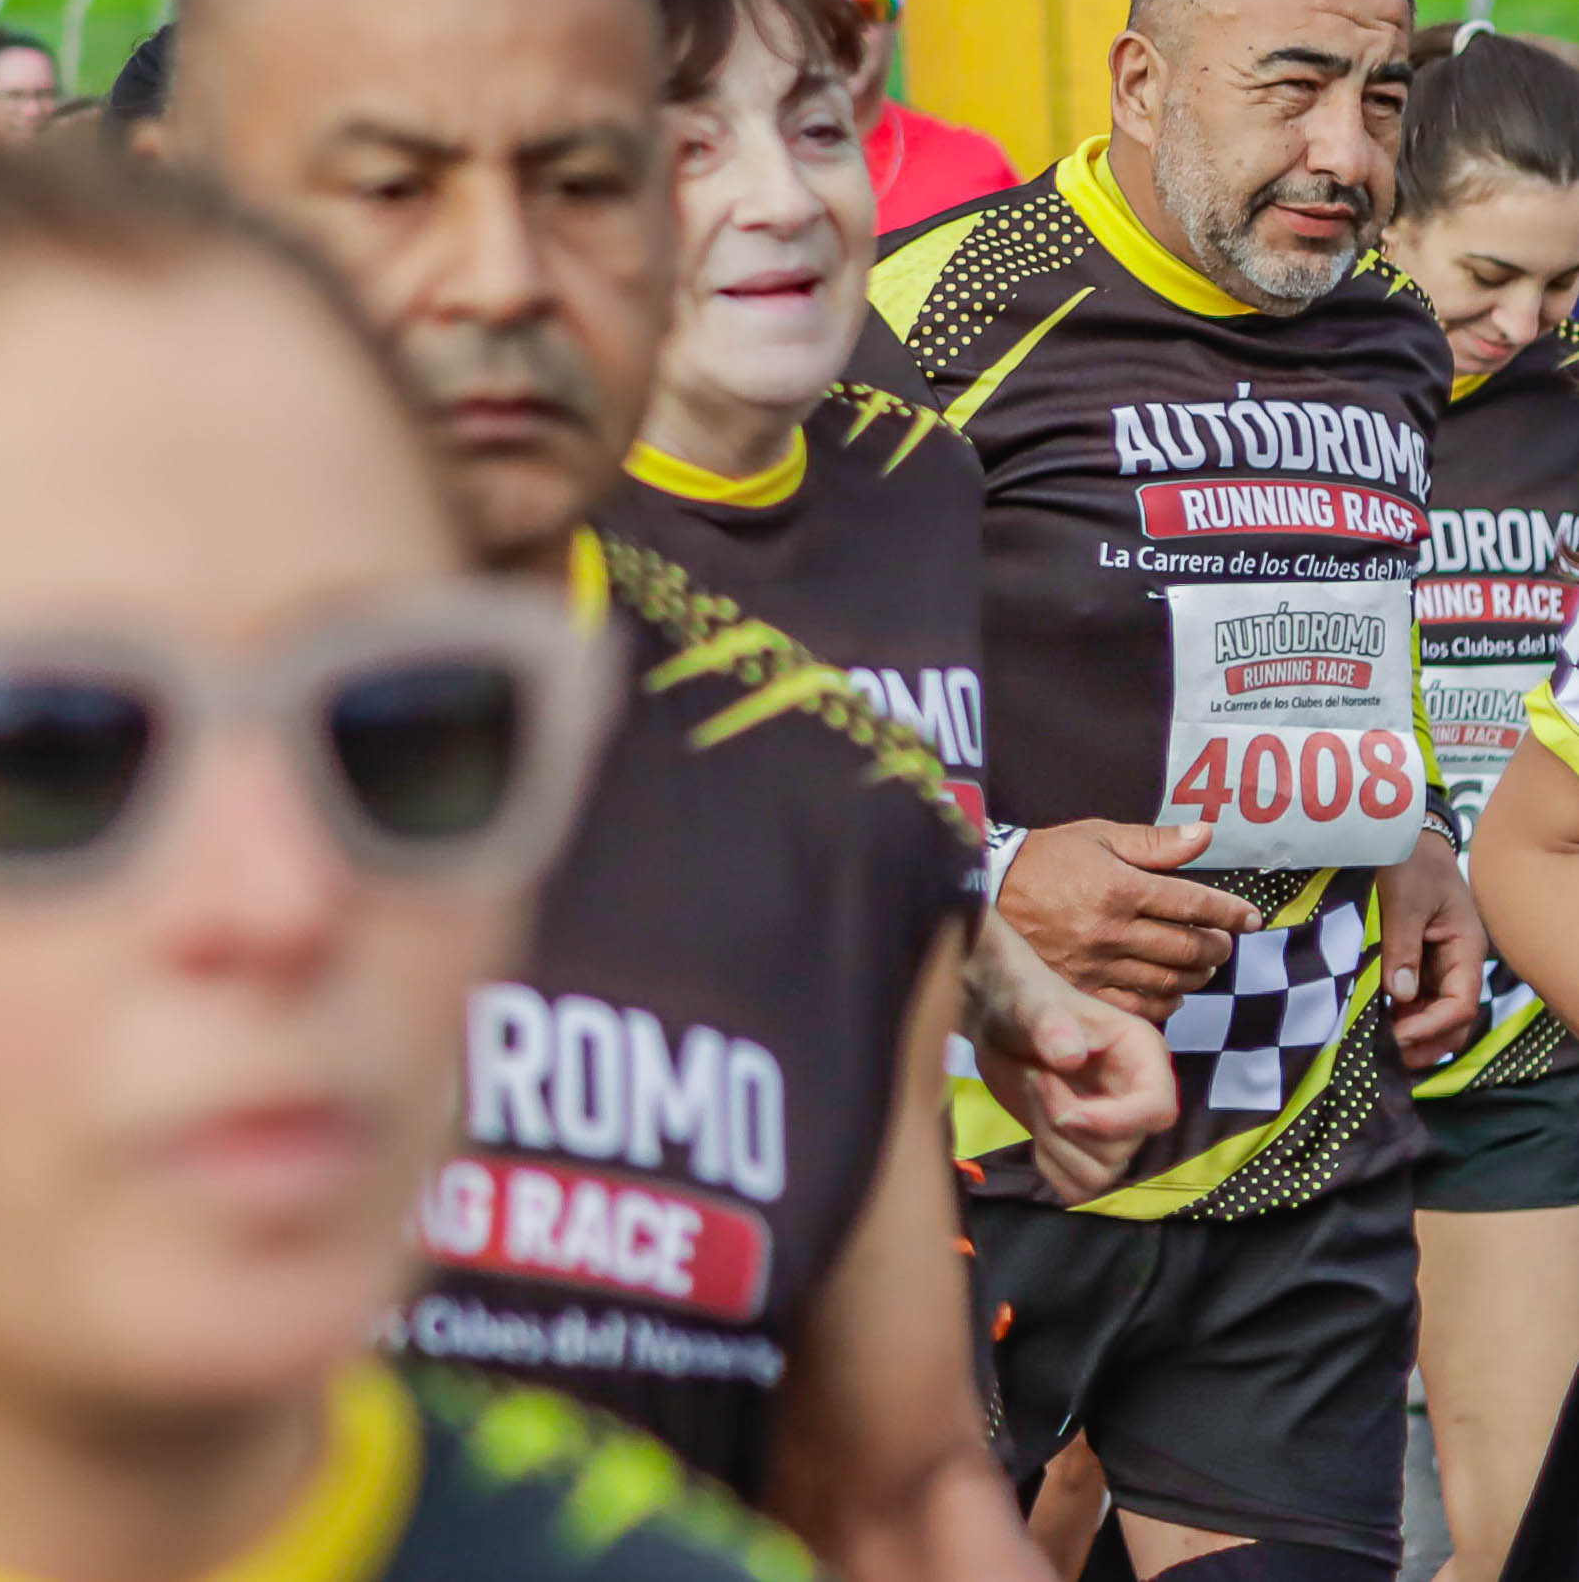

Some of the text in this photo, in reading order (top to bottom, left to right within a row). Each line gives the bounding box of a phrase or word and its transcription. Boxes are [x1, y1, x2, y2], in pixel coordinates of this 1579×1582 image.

[1180, 485, 1334, 531] RUNNING
[1099, 542, 1130, 568] La
[1137, 546, 1225, 574] Carrera
[1229, 550, 1256, 574] de
[1260, 552, 1290, 576] los
[1294, 554, 1359, 580] Clubes
[1364, 557, 1393, 580] del
[1492, 582, 1564, 622] RACE
[1215, 601, 1386, 664] AUTÓDROMO
[1422, 637, 1449, 658] los
[1451, 635, 1515, 659] Clubes
[1518, 633, 1546, 657] del
[1243, 660, 1356, 689] RUNNING RACE
[1224, 698, 1258, 712] Carrera
[1260, 697, 1273, 710] de
[1275, 697, 1289, 709] los
[1292, 696, 1323, 709] Clubes
[1325, 695, 1339, 708] del
[1342, 695, 1381, 708] Noroeste
[1171, 729, 1414, 824] 4008
[504, 1166, 703, 1299] RACE
